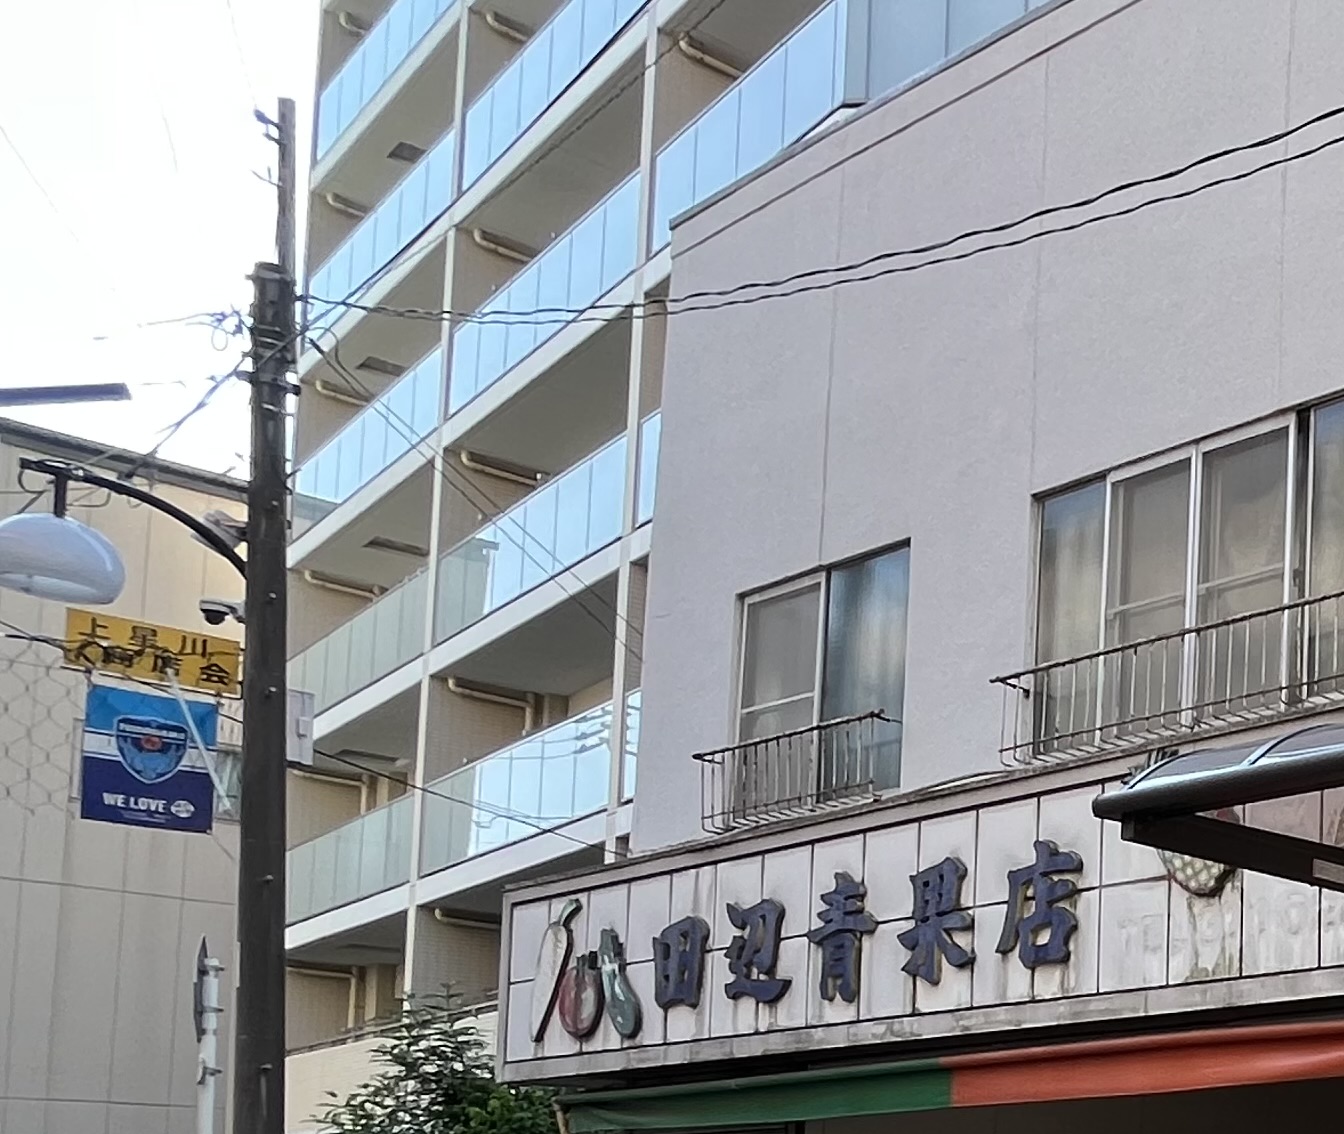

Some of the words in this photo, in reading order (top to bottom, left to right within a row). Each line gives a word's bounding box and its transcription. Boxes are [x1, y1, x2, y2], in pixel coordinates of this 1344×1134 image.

[77, 616, 208, 658] 上星川
[102, 792, 127, 808] WE
[129, 796, 168, 813] LOVE
[652, 838, 1084, 1010] 田辺青果店
